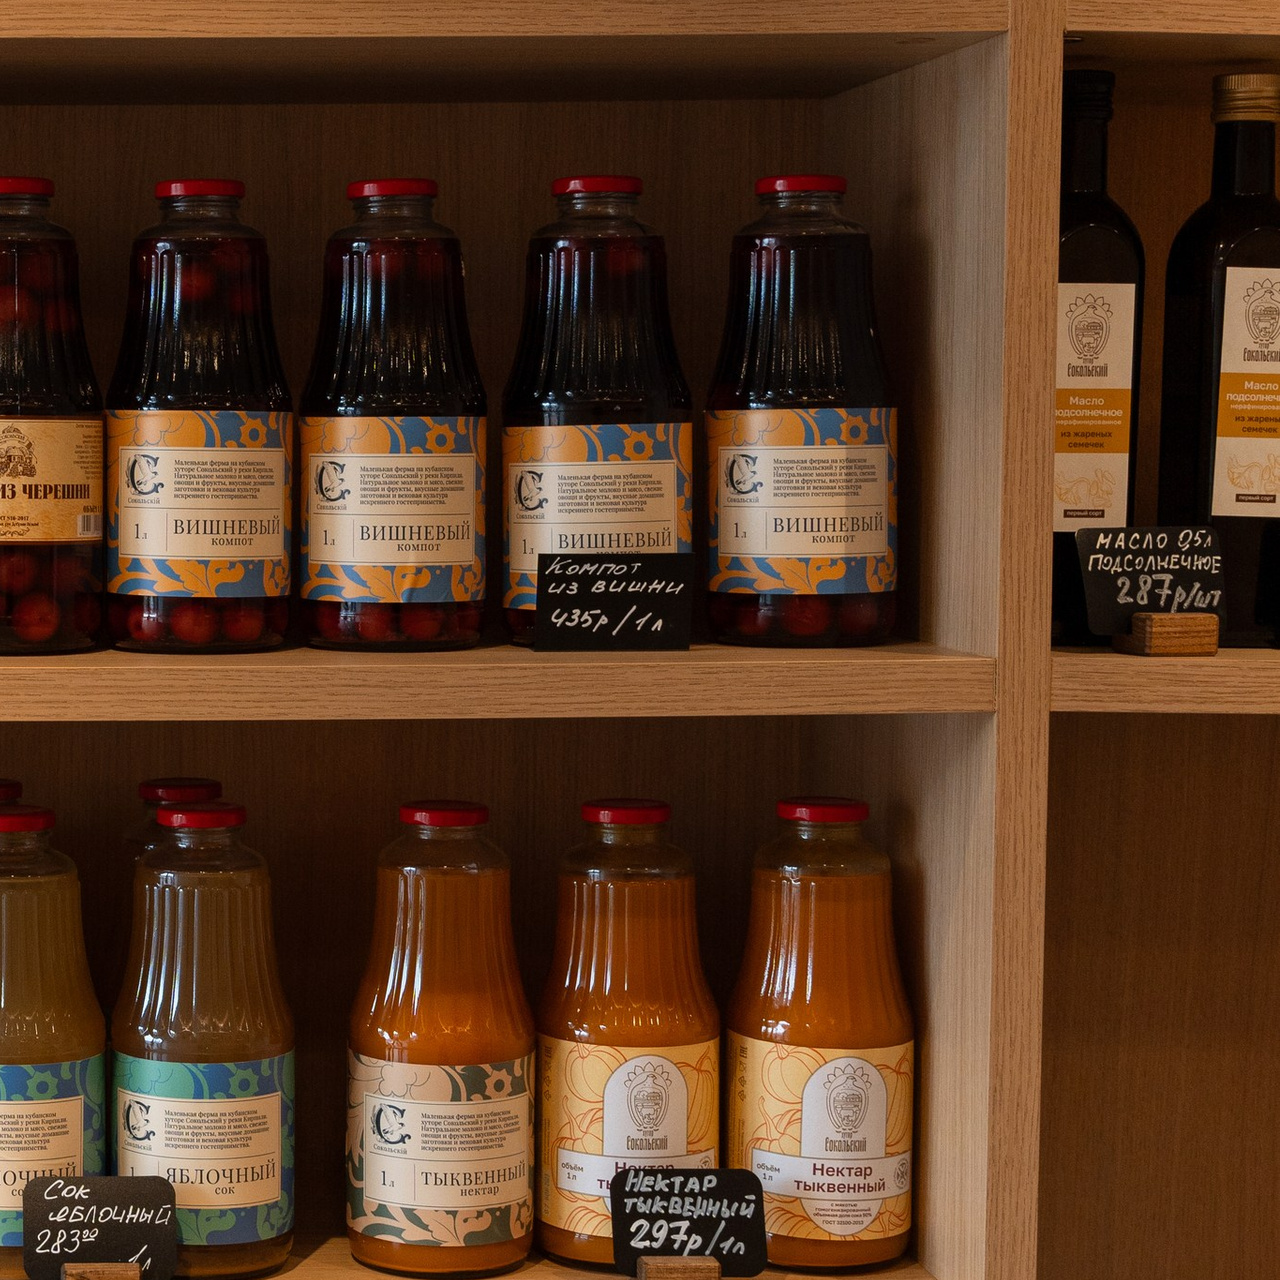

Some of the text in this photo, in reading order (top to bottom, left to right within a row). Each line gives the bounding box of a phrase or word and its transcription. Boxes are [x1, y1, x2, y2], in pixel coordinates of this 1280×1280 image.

[1245, 381, 1279, 391] Масло
[1070, 396, 1104, 405] Масло
[22, 484, 90, 499] ЧЕРЕШНИ
[173, 516, 281, 535] ВИШНЕВЫЙ
[773, 512, 883, 532] ВИШНЕВЫЙ
[360, 522, 471, 541] ВИШНЕВЫЙ
[558, 528, 672, 549] ВИШНЕВЫЙ
[211, 536, 254, 547] компот
[397, 542, 441, 552] компот
[1096, 533, 1167, 549] МАСЛО
[545, 557, 641, 576] КОМПОТ
[1088, 554, 1221, 574] ПОДСОЛНЕЧНОЕ
[592, 581, 684, 595] ВИШНИ
[166, 1159, 276, 1185] ЯБЛОЧНЫЙ
[421, 1161, 526, 1186] ТЫКВЕННЫЙ
[561, 1162, 583, 1172] объём
[757, 1163, 780, 1173] объём
[813, 1163, 872, 1180] Нектар
[214, 1185, 235, 1194] сок
[625, 1170, 717, 1193] НЕКТАР
[794, 1178, 885, 1193] тыквенный
[460, 1186, 499, 1196] нектар
[49, 1204, 171, 1225] ЯБЛОЧНЫЙ
[624, 1195, 755, 1218] ТЫКВЕННЫЙ
